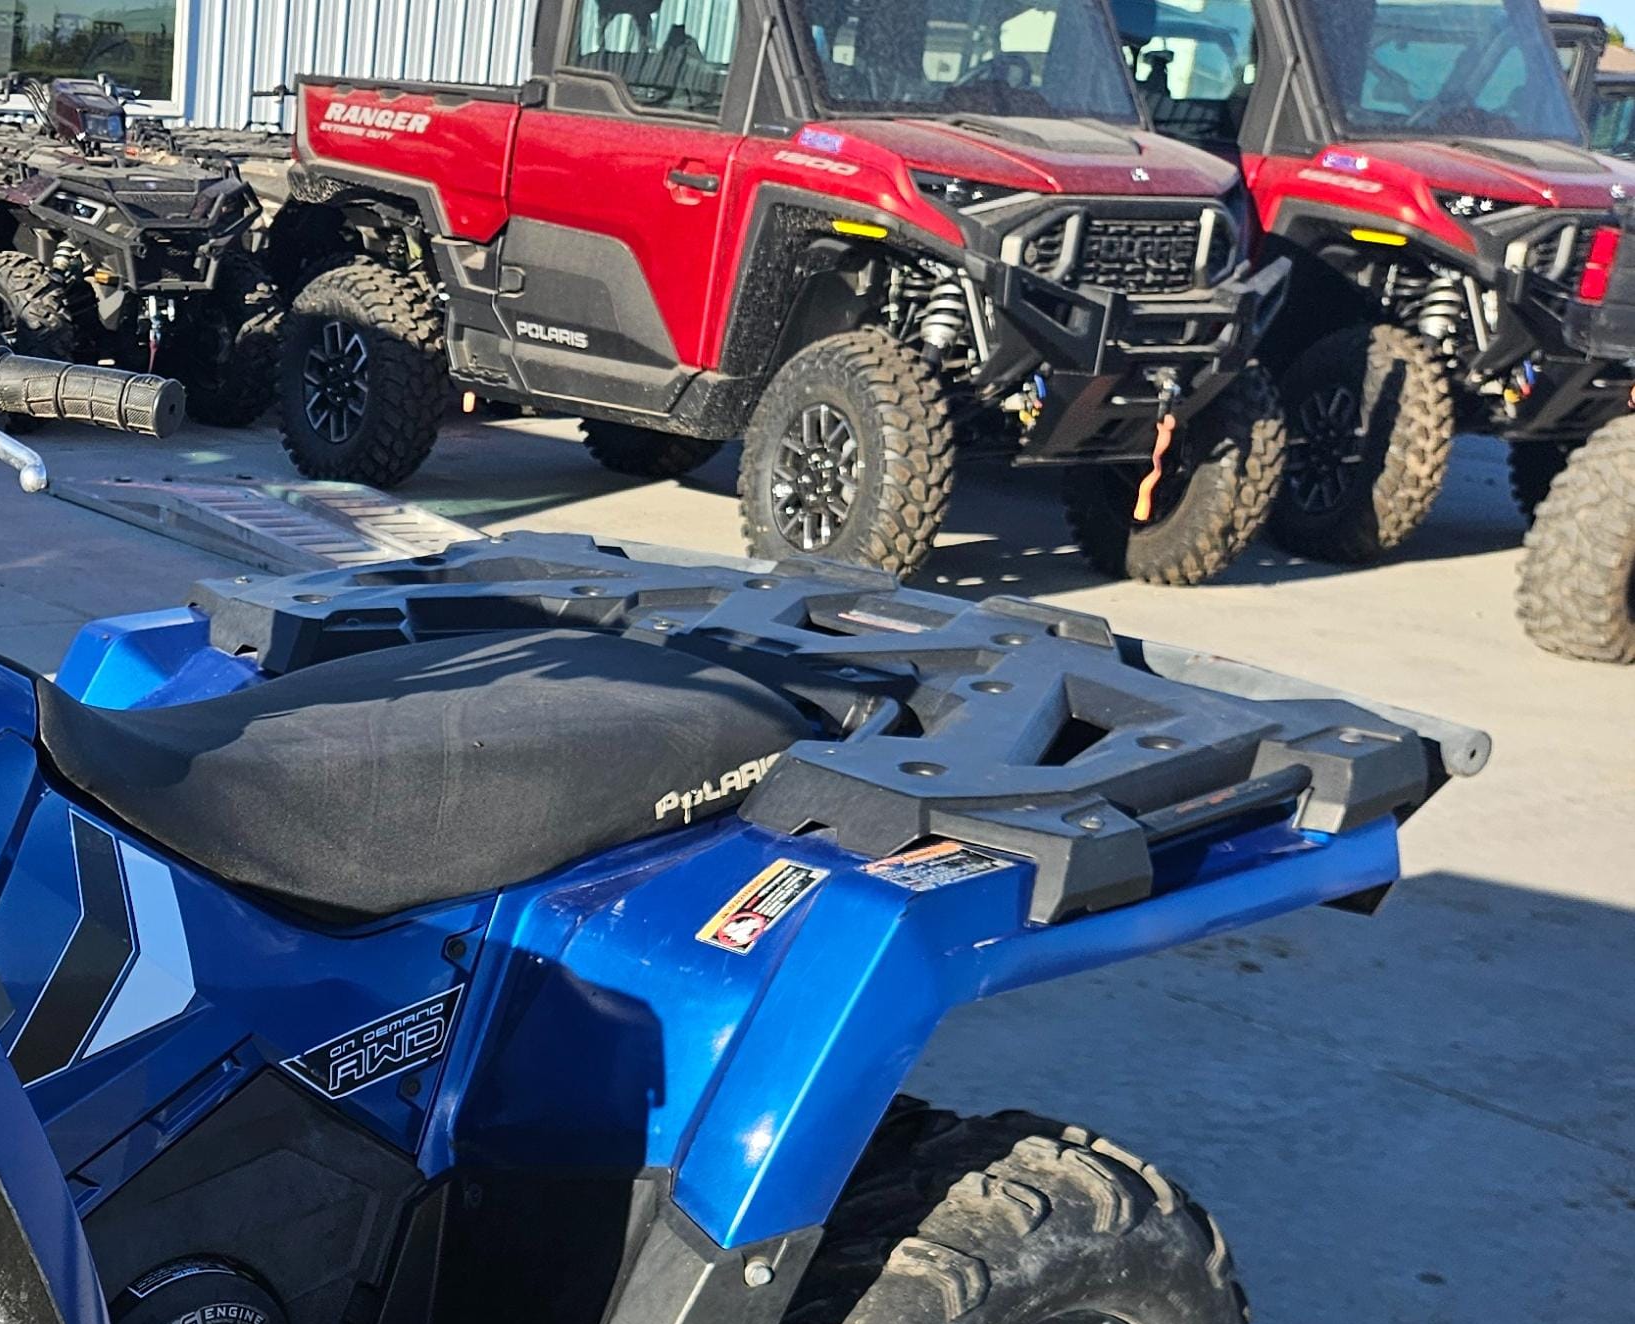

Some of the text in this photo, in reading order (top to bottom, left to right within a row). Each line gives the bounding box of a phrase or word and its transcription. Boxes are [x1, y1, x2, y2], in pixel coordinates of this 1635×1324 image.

[324, 101, 432, 134] RANGER
[365, 128, 395, 142] DUTY
[516, 320, 589, 349] POLARIS
[329, 1002, 445, 1059] ON DEMAND
[328, 1017, 445, 1091] AWD
